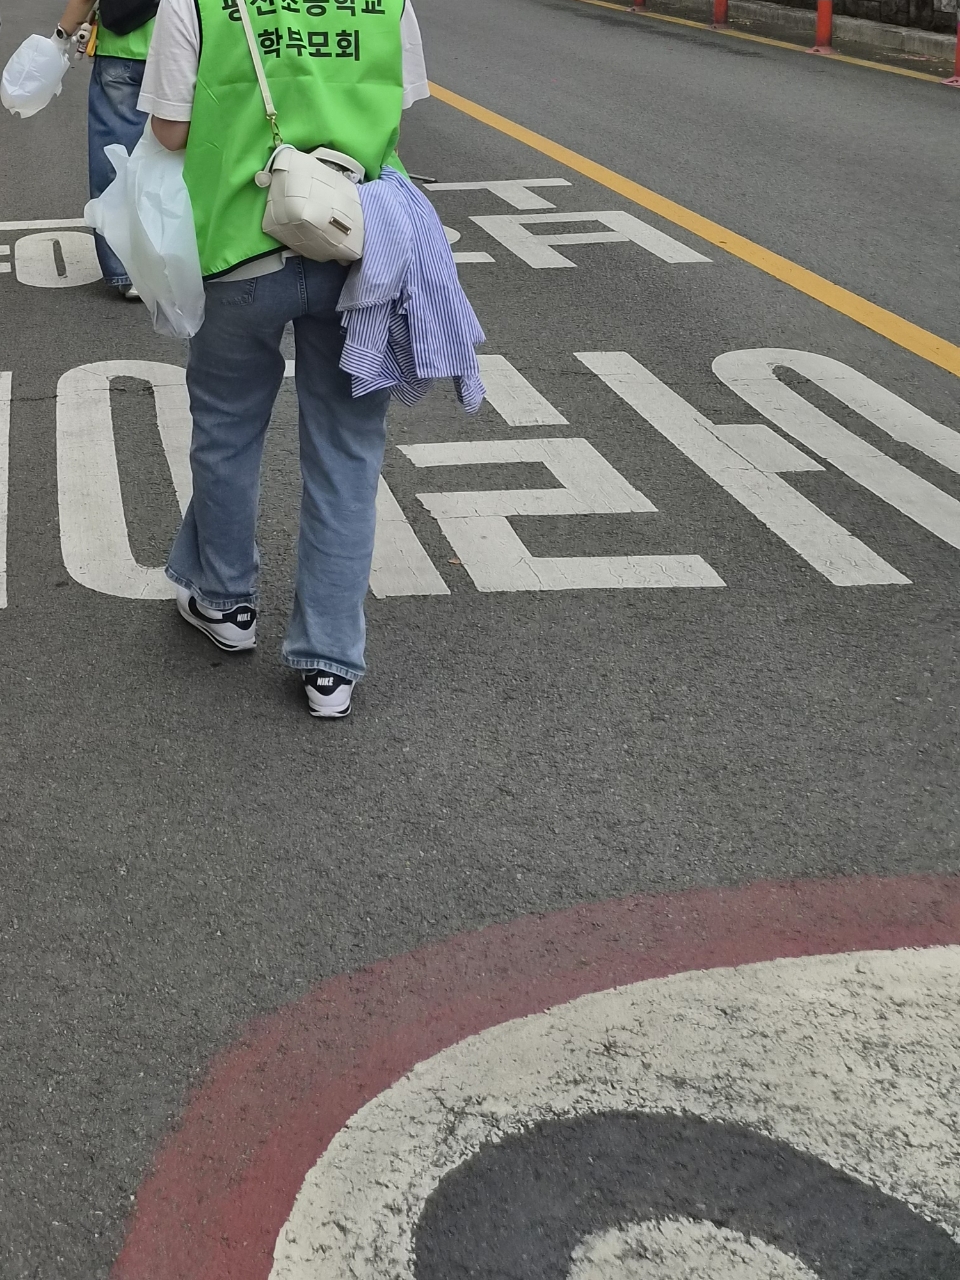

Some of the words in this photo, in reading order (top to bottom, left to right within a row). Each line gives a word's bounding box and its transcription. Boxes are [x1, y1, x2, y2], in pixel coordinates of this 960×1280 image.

[257, 26, 361, 62] 학부모회
[236, 612, 252, 623] NIKE
[316, 676, 334, 687] NIKE
